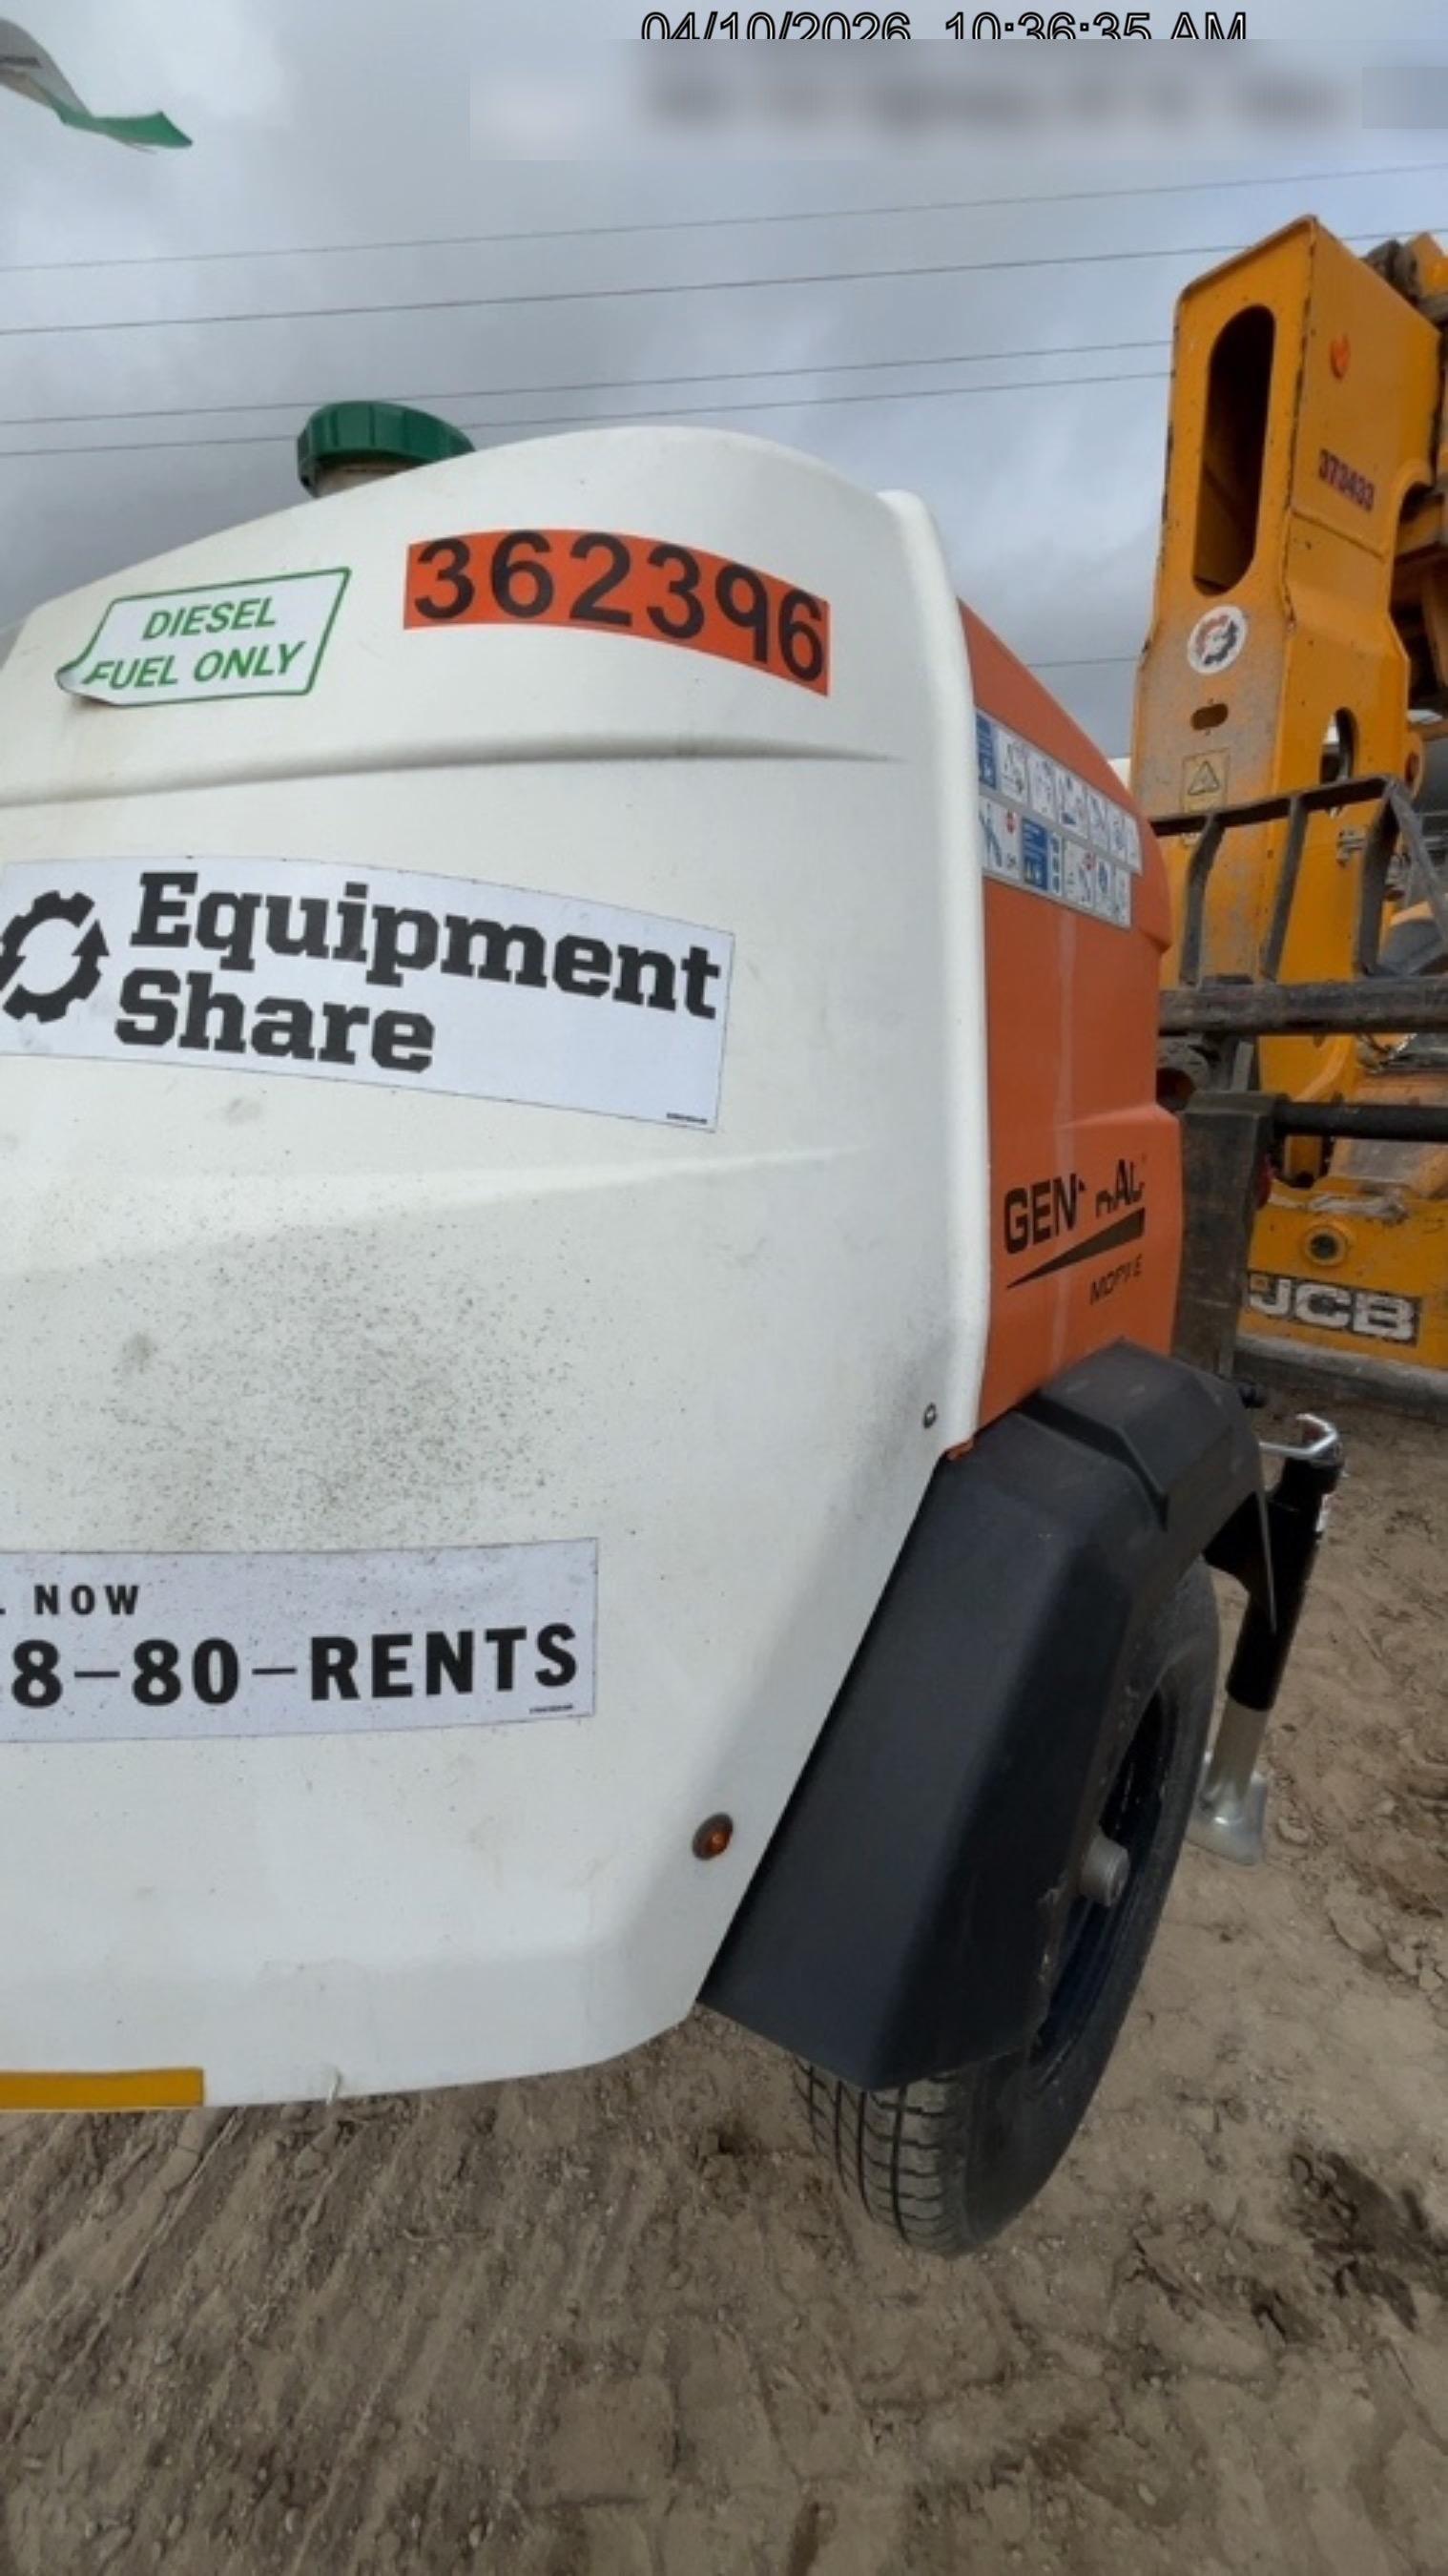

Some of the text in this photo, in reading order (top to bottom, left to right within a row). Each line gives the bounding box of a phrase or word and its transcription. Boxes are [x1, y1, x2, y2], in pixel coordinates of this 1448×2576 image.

[142, 596, 276, 640] DIESEL
[413, 530, 825, 682] 362396
[81, 641, 306, 690] FUEL ONLY
[130, 872, 720, 1019] Equipment
[114, 968, 436, 1073] Share
[1251, 1278, 1414, 1340] JCB
[34, 1585, 139, 1614] NOW
